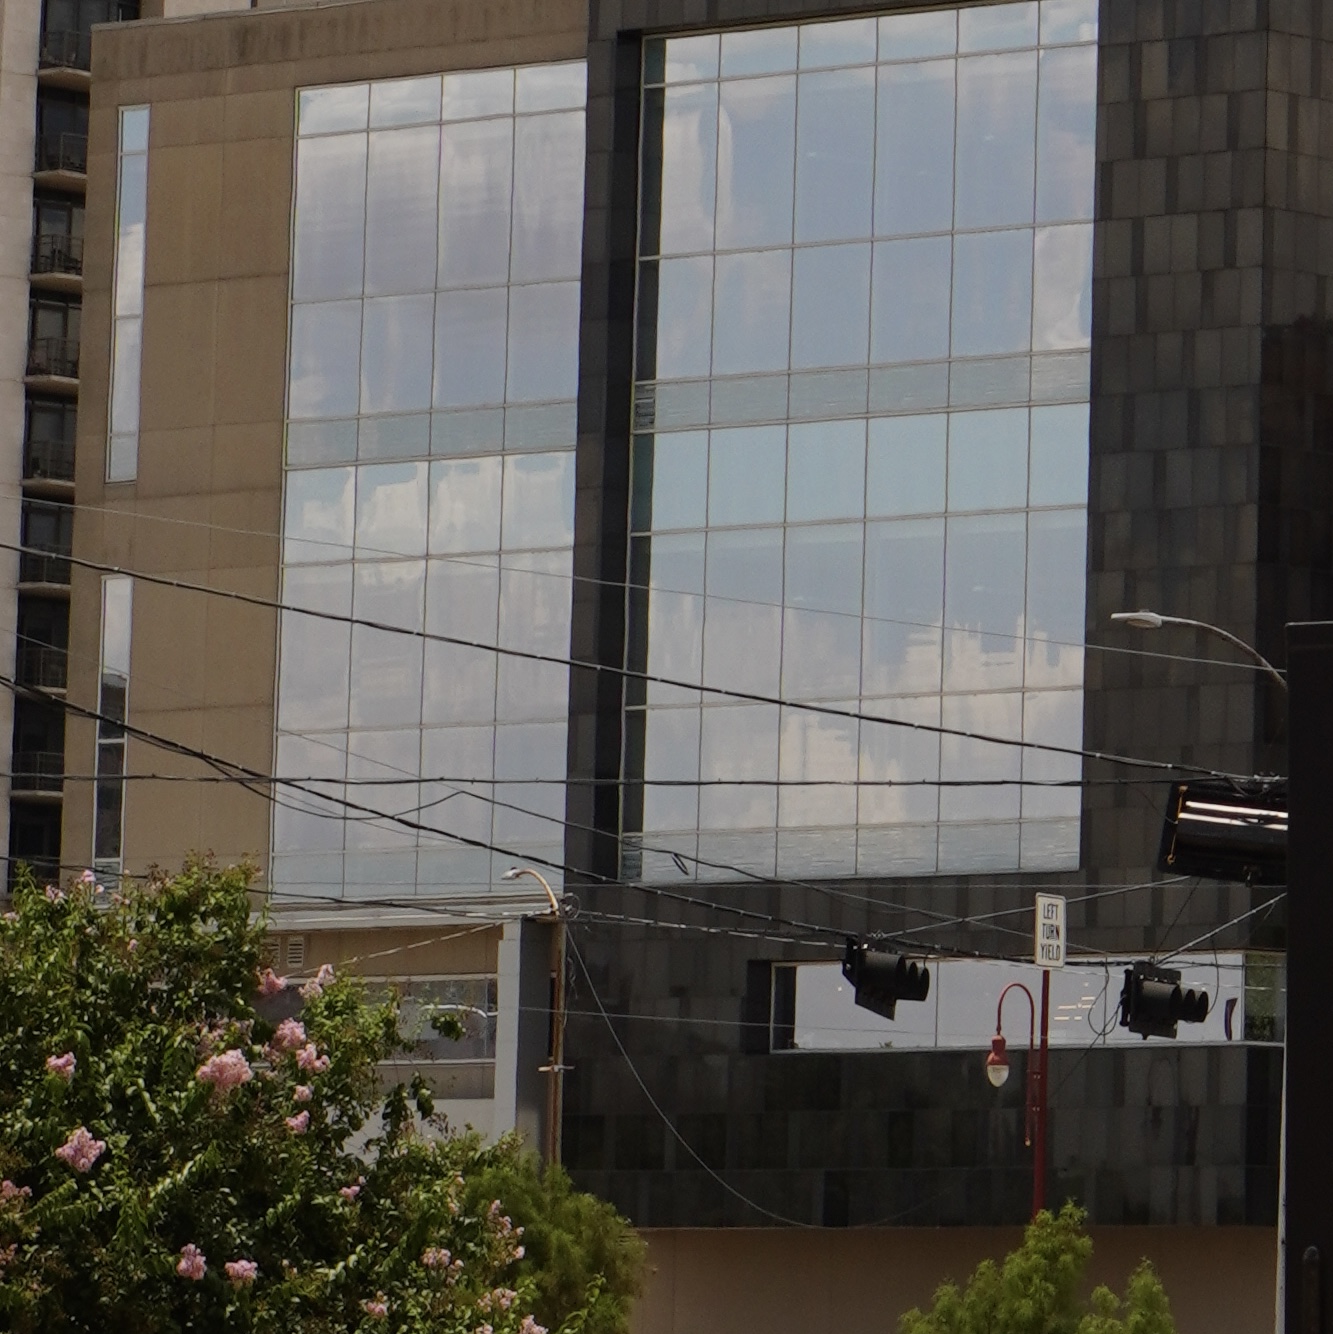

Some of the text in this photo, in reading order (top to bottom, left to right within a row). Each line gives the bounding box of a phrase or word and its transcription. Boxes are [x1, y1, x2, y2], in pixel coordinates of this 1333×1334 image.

[1043, 903, 1059, 920] LEFT
[1041, 924, 1061, 940] TURN
[1040, 943, 1061, 961] YIELD
